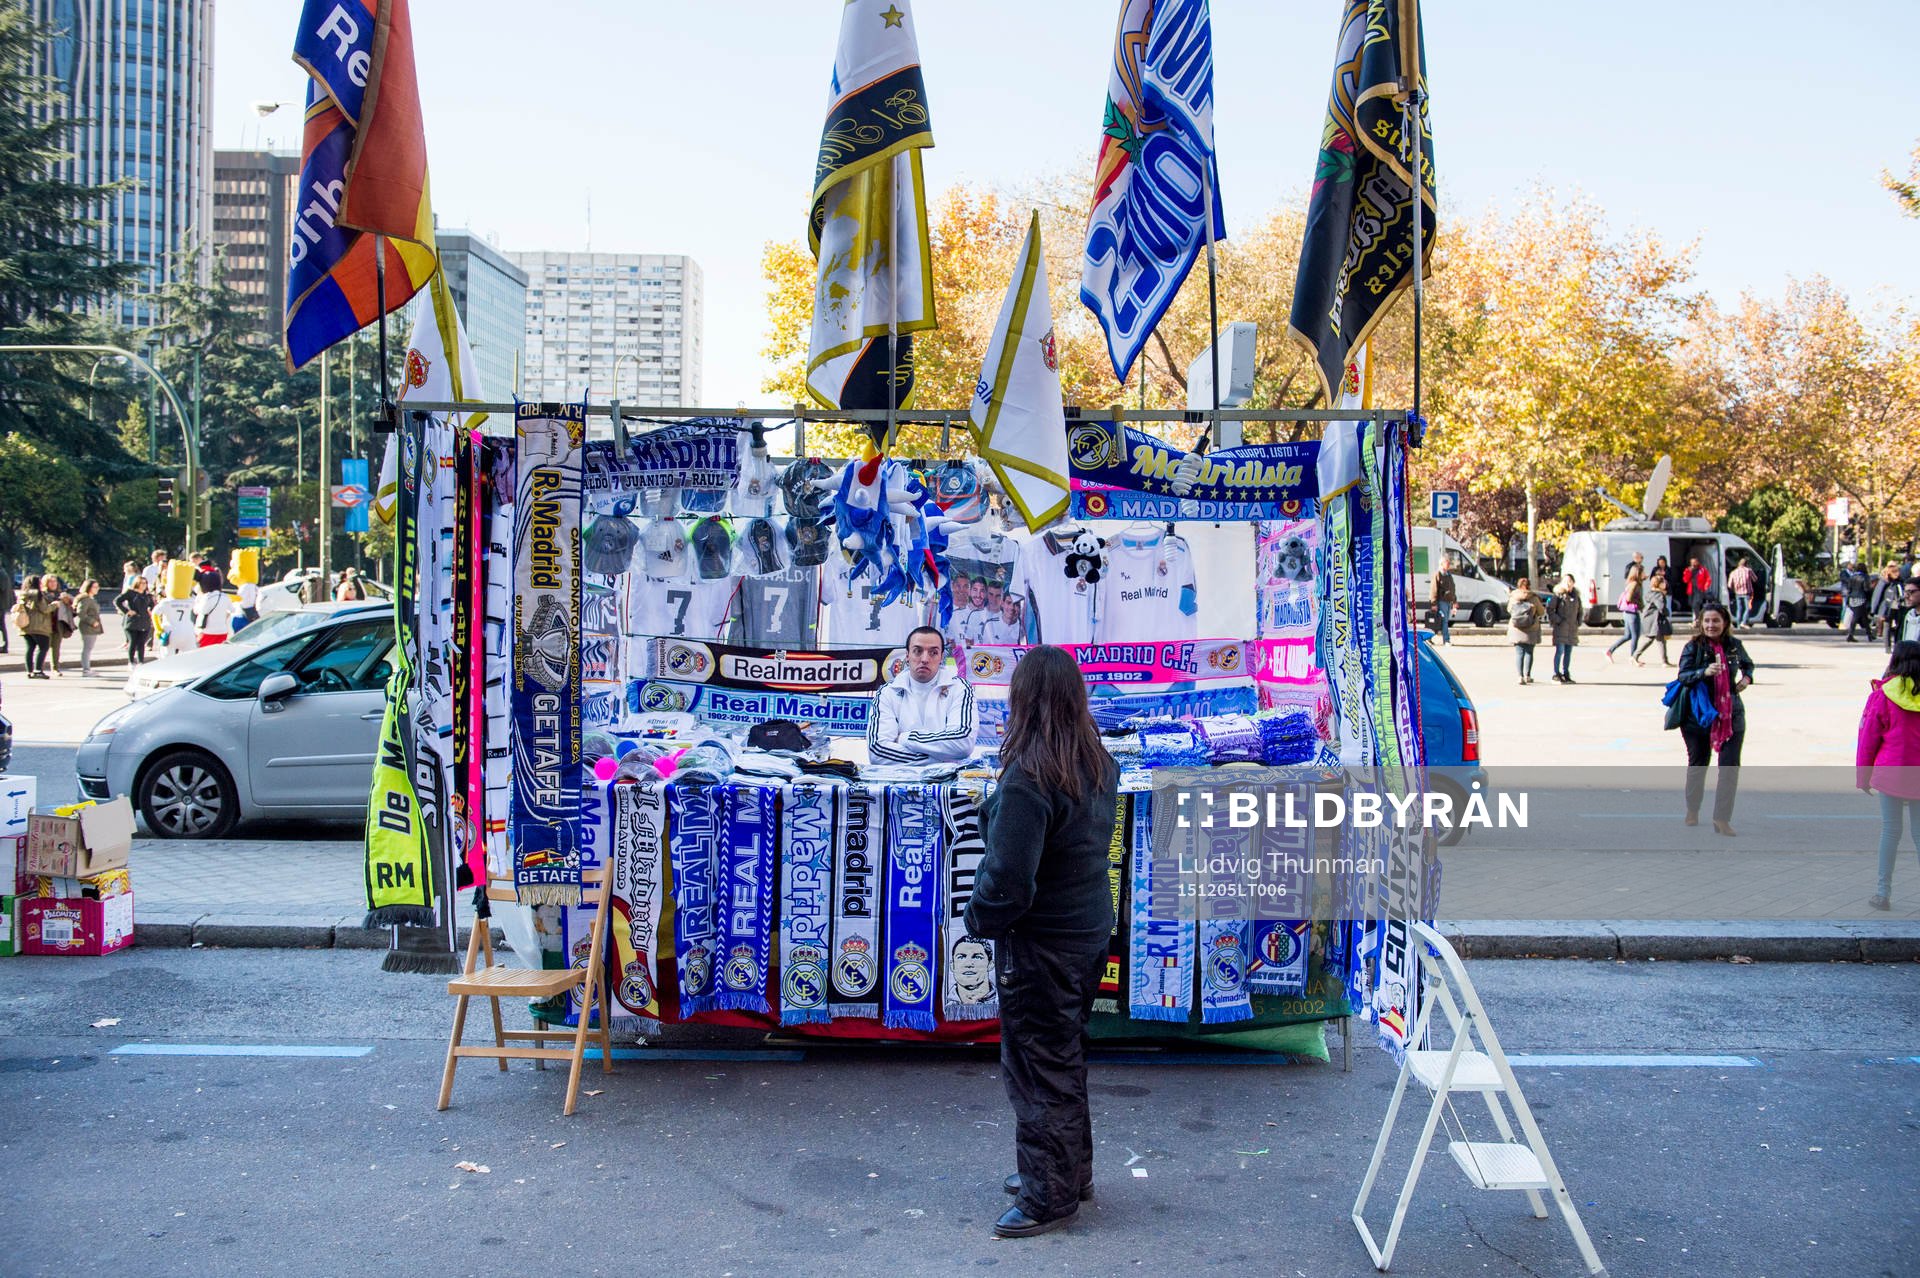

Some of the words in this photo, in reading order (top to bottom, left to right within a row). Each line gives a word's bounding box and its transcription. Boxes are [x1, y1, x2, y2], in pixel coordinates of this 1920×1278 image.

[630, 436, 738, 472] MADRID
[1270, 446, 1293, 458] LISTO
[1293, 445, 1301, 457] Y
[611, 475, 620, 490] 7
[625, 473, 674, 488] JUANITO
[678, 471, 687, 486] 7
[1121, 499, 1265, 519] MADDISTA
[569, 527, 580, 627] CAMPEONATO
[667, 589, 692, 634] 7
[763, 586, 789, 634] 7
[1120, 588, 1142, 602] Real
[570, 628, 581, 703] NACIONAL
[734, 658, 863, 682] Realmadrid
[1075, 645, 1155, 665] MADRID
[1161, 643, 1198, 674] C.F.
[1107, 671, 1143, 681] 1902
[570, 705, 580, 722] DE
[711, 693, 767, 714] Real
[776, 697, 868, 720] Madrid
[532, 693, 563, 807] GETAFE
[571, 724, 582, 764] LIGA
[378, 790, 412, 836] De
[618, 786, 629, 829] SIEMPRE
[922, 819, 934, 873] Santiago
[377, 862, 416, 889] RM
[518, 869, 580, 884] GETAFE
[618, 858, 628, 890] LADO
[791, 807, 823, 941] Madrid
[898, 838, 924, 908] Real
[1135, 857, 1143, 873] FASE
[681, 834, 714, 940] REAL
[730, 833, 761, 938] REAL
[1282, 1000, 1326, 1015] 2002
